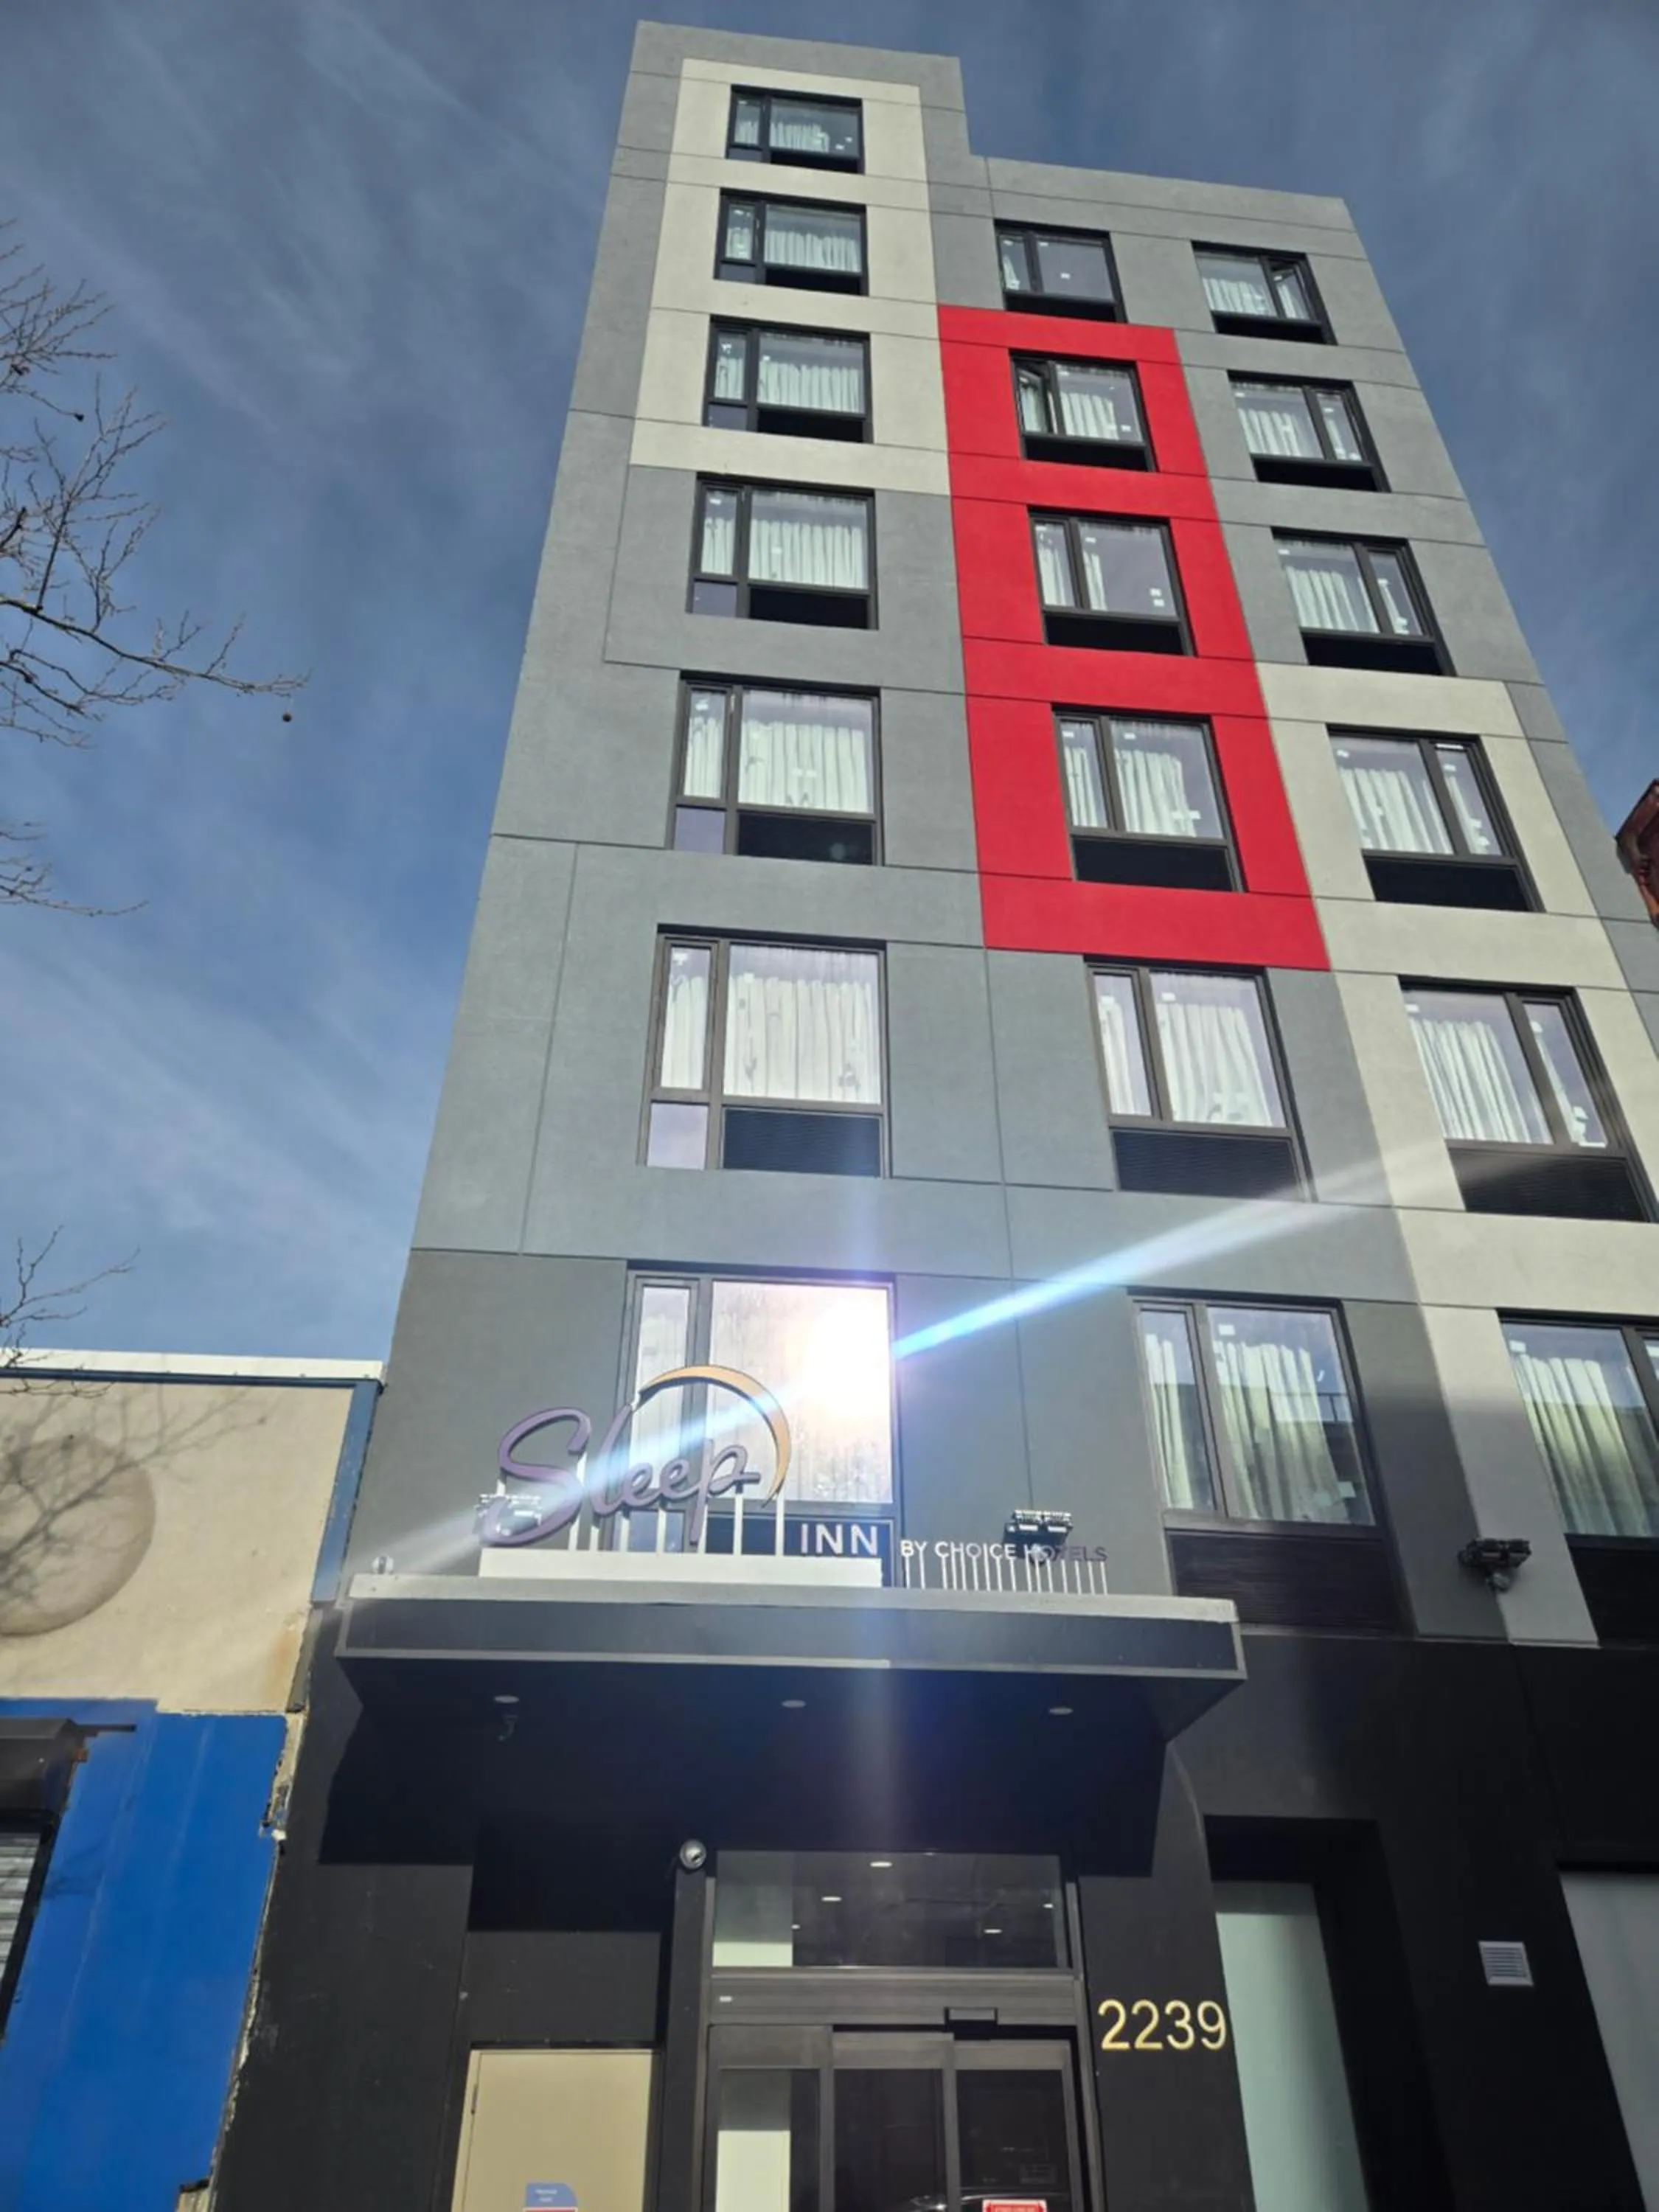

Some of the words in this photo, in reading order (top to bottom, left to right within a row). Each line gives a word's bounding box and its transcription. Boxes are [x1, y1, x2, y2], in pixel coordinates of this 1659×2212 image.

[480, 1403, 761, 1546] Sleep
[801, 1523, 878, 1556] INN
[900, 1539, 928, 1558] BY
[934, 1541, 1017, 1560] CHOICE
[1097, 1999, 1226, 2050] 2239
